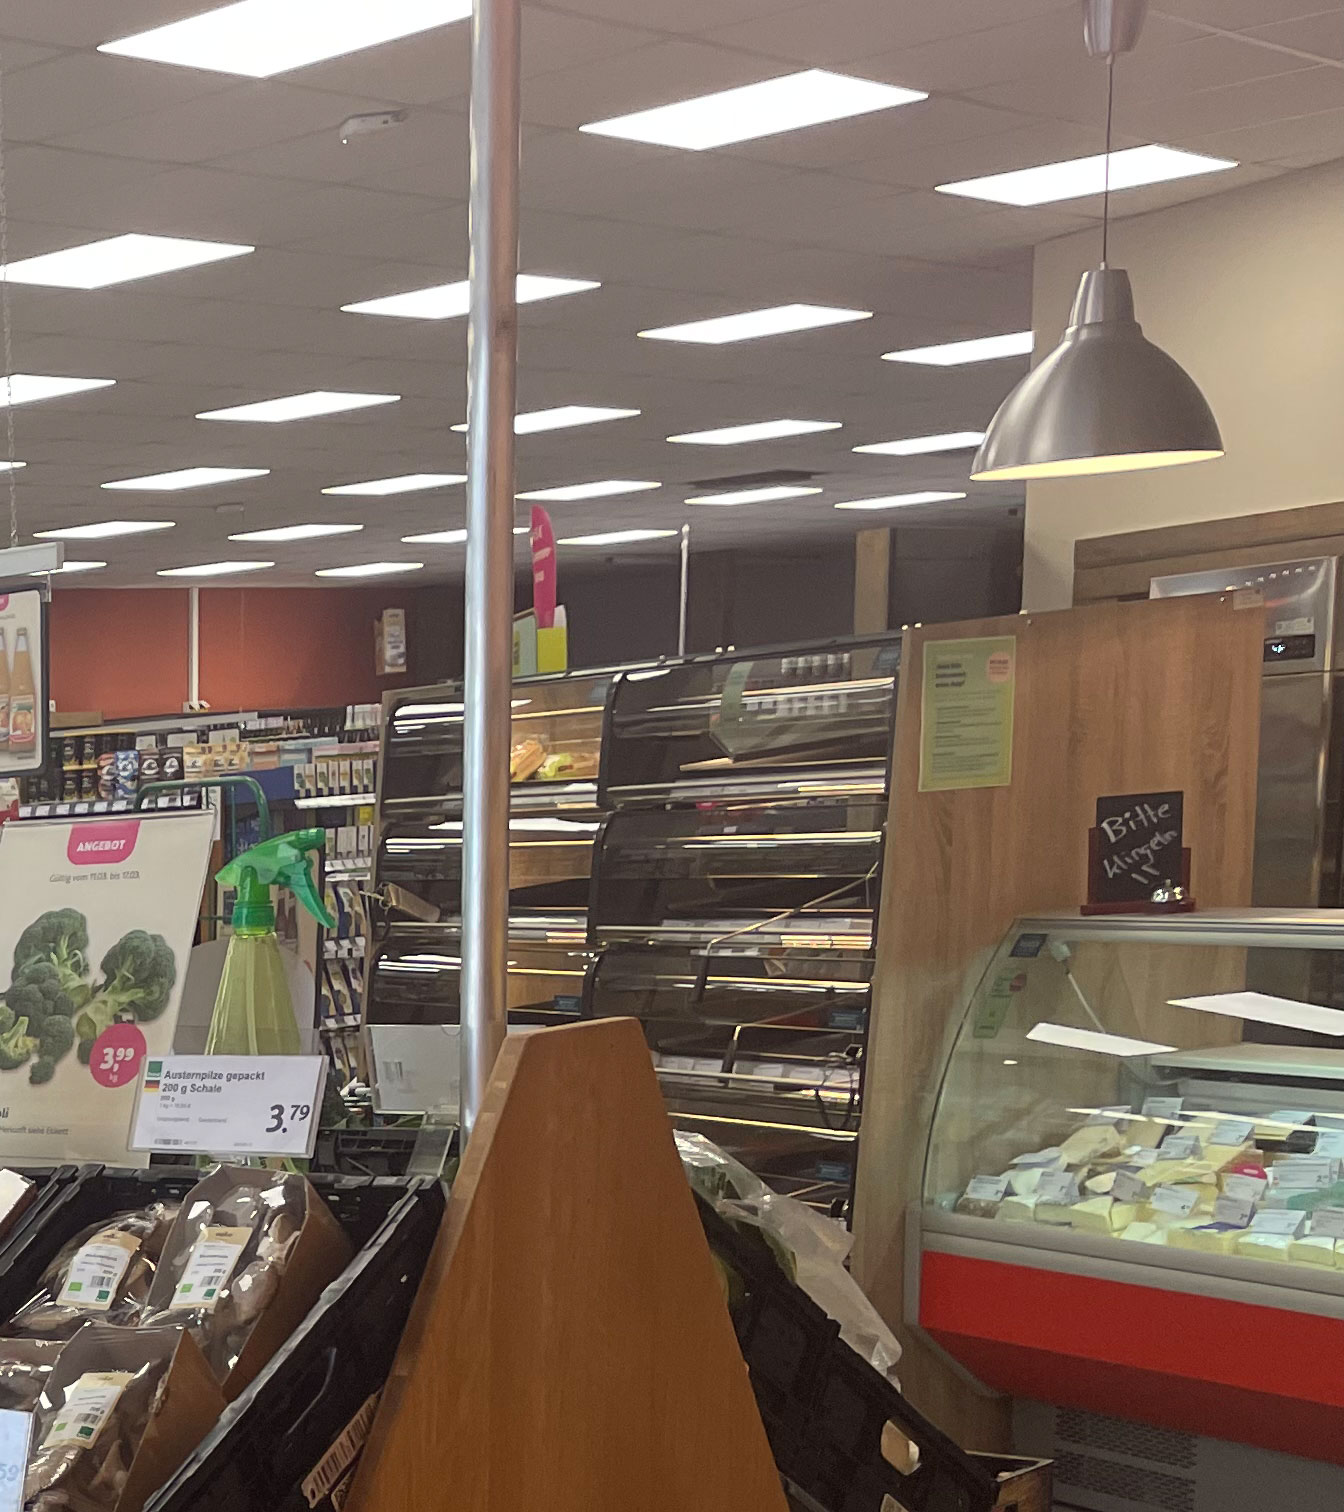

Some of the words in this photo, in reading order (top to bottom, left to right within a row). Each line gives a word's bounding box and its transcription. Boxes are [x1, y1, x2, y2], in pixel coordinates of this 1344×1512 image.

[1101, 804, 1171, 843] Bitte
[76, 839, 126, 852] ANGEBOT
[164, 1070, 223, 1082] Austernpilze
[226, 1071, 265, 1083] gepackt
[162, 1083, 179, 1094] 200
[190, 1083, 222, 1094] Schale
[266, 1104, 310, 1134] 3.79
